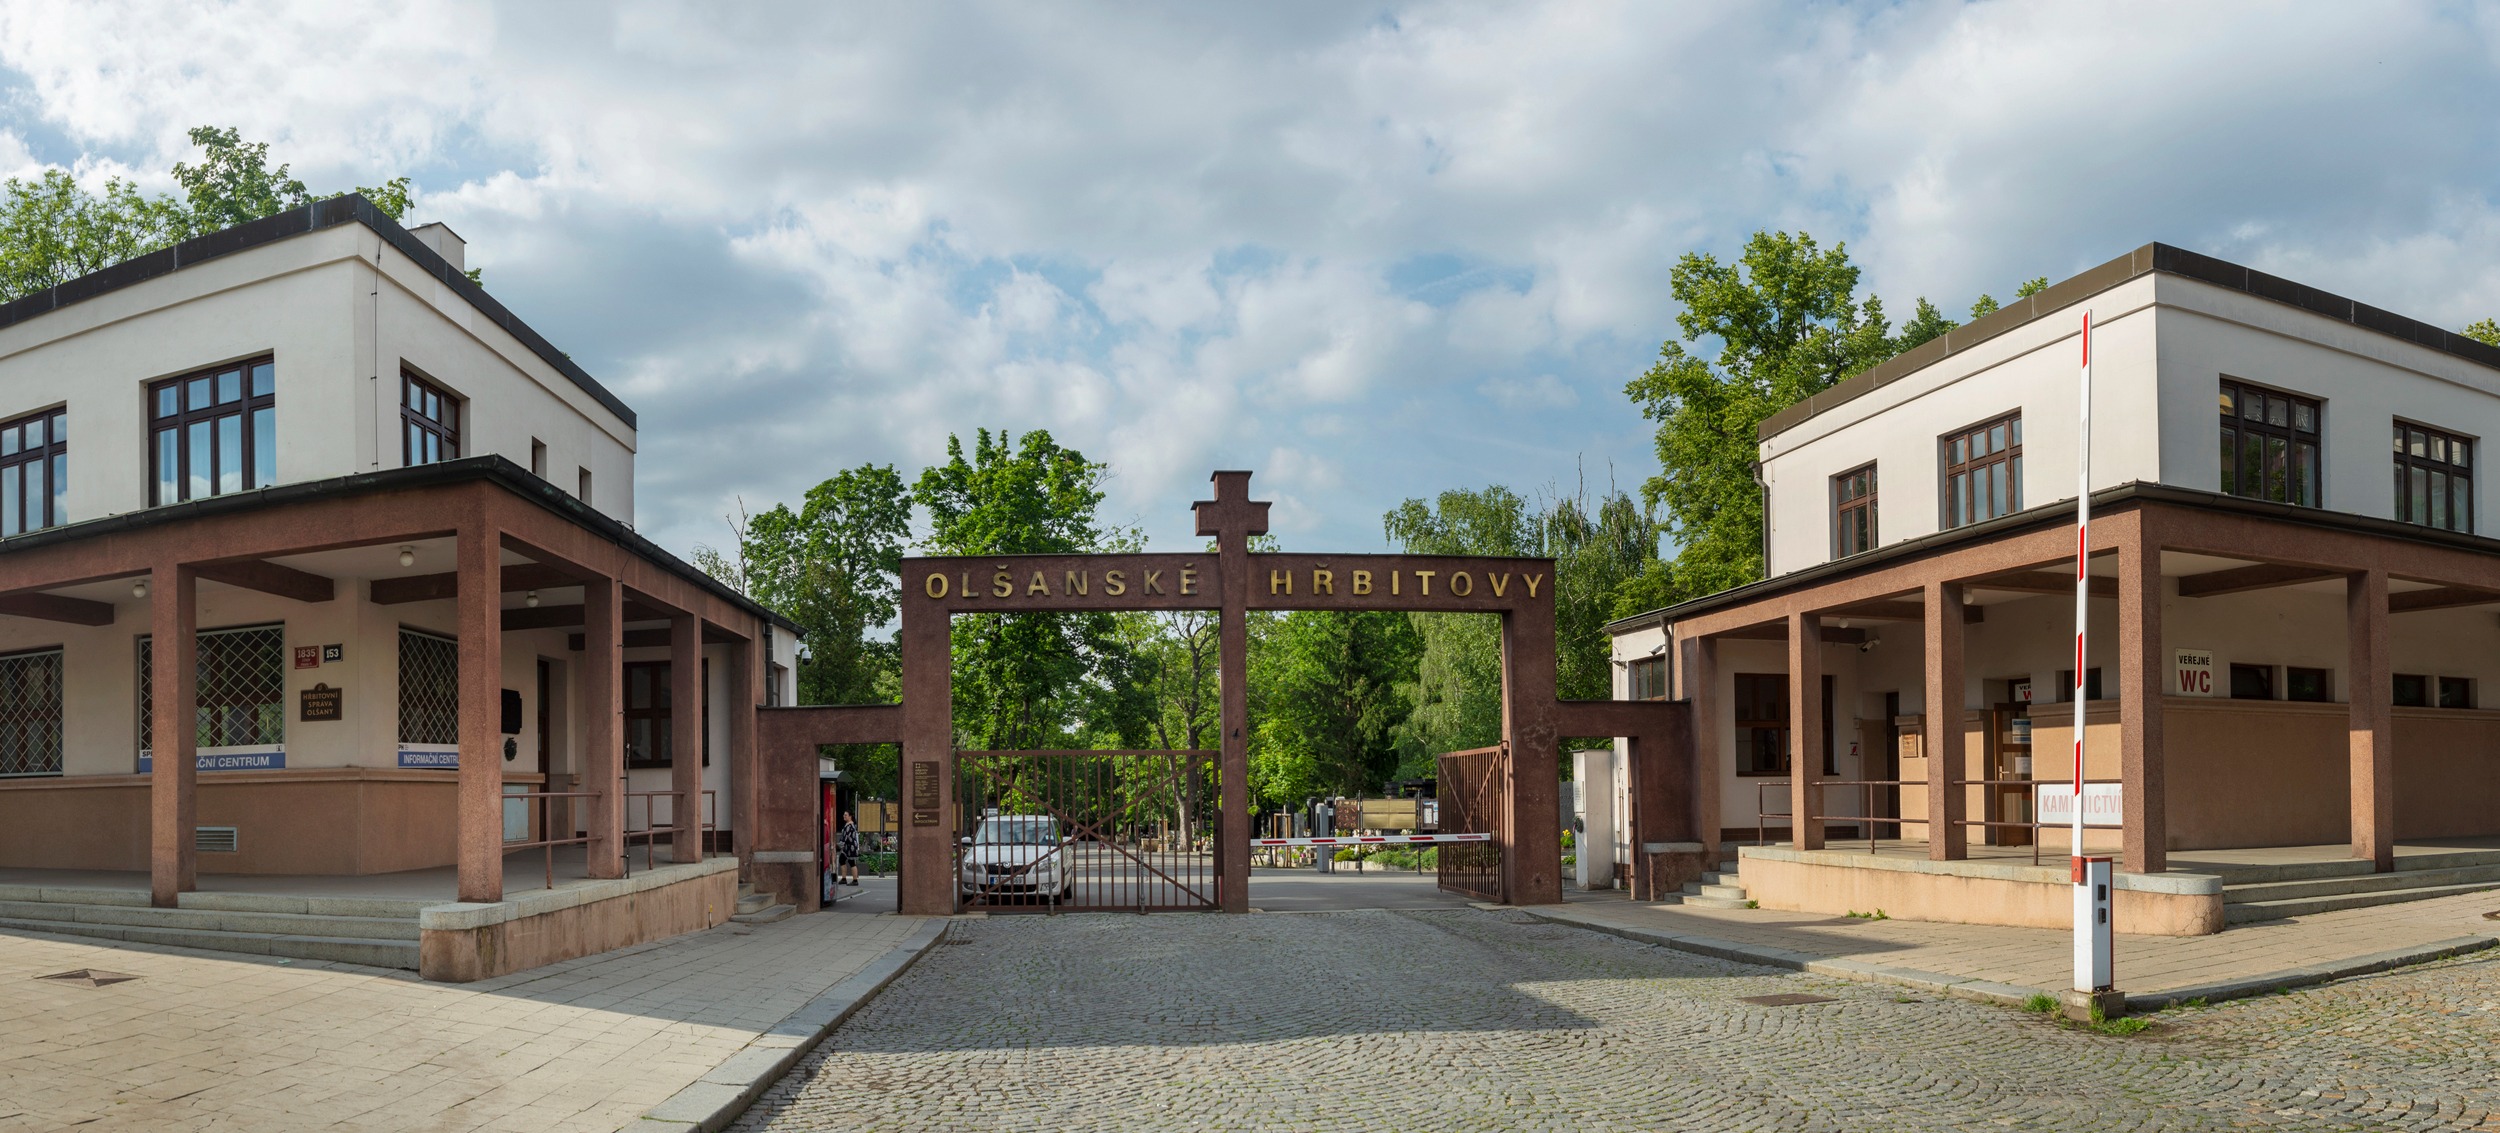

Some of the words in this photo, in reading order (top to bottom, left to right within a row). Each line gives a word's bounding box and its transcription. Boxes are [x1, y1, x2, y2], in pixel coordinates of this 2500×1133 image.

[925, 563, 1198, 599] OLŠANSKÉ
[1270, 563, 1544, 598] HŘBITOVY
[297, 649, 316, 658] 1835
[326, 649, 339, 658] 153
[2178, 654, 2210, 666] VEŘEJNÉ
[2179, 669, 2211, 693] WC
[303, 692, 338, 700] HŘBITOVNÍ
[308, 700, 333, 708] SPRÁVA
[306, 708, 334, 716] OLŠANY
[218, 756, 270, 767] CENTRUM
[403, 752, 438, 764] INFORMAČNÍ
